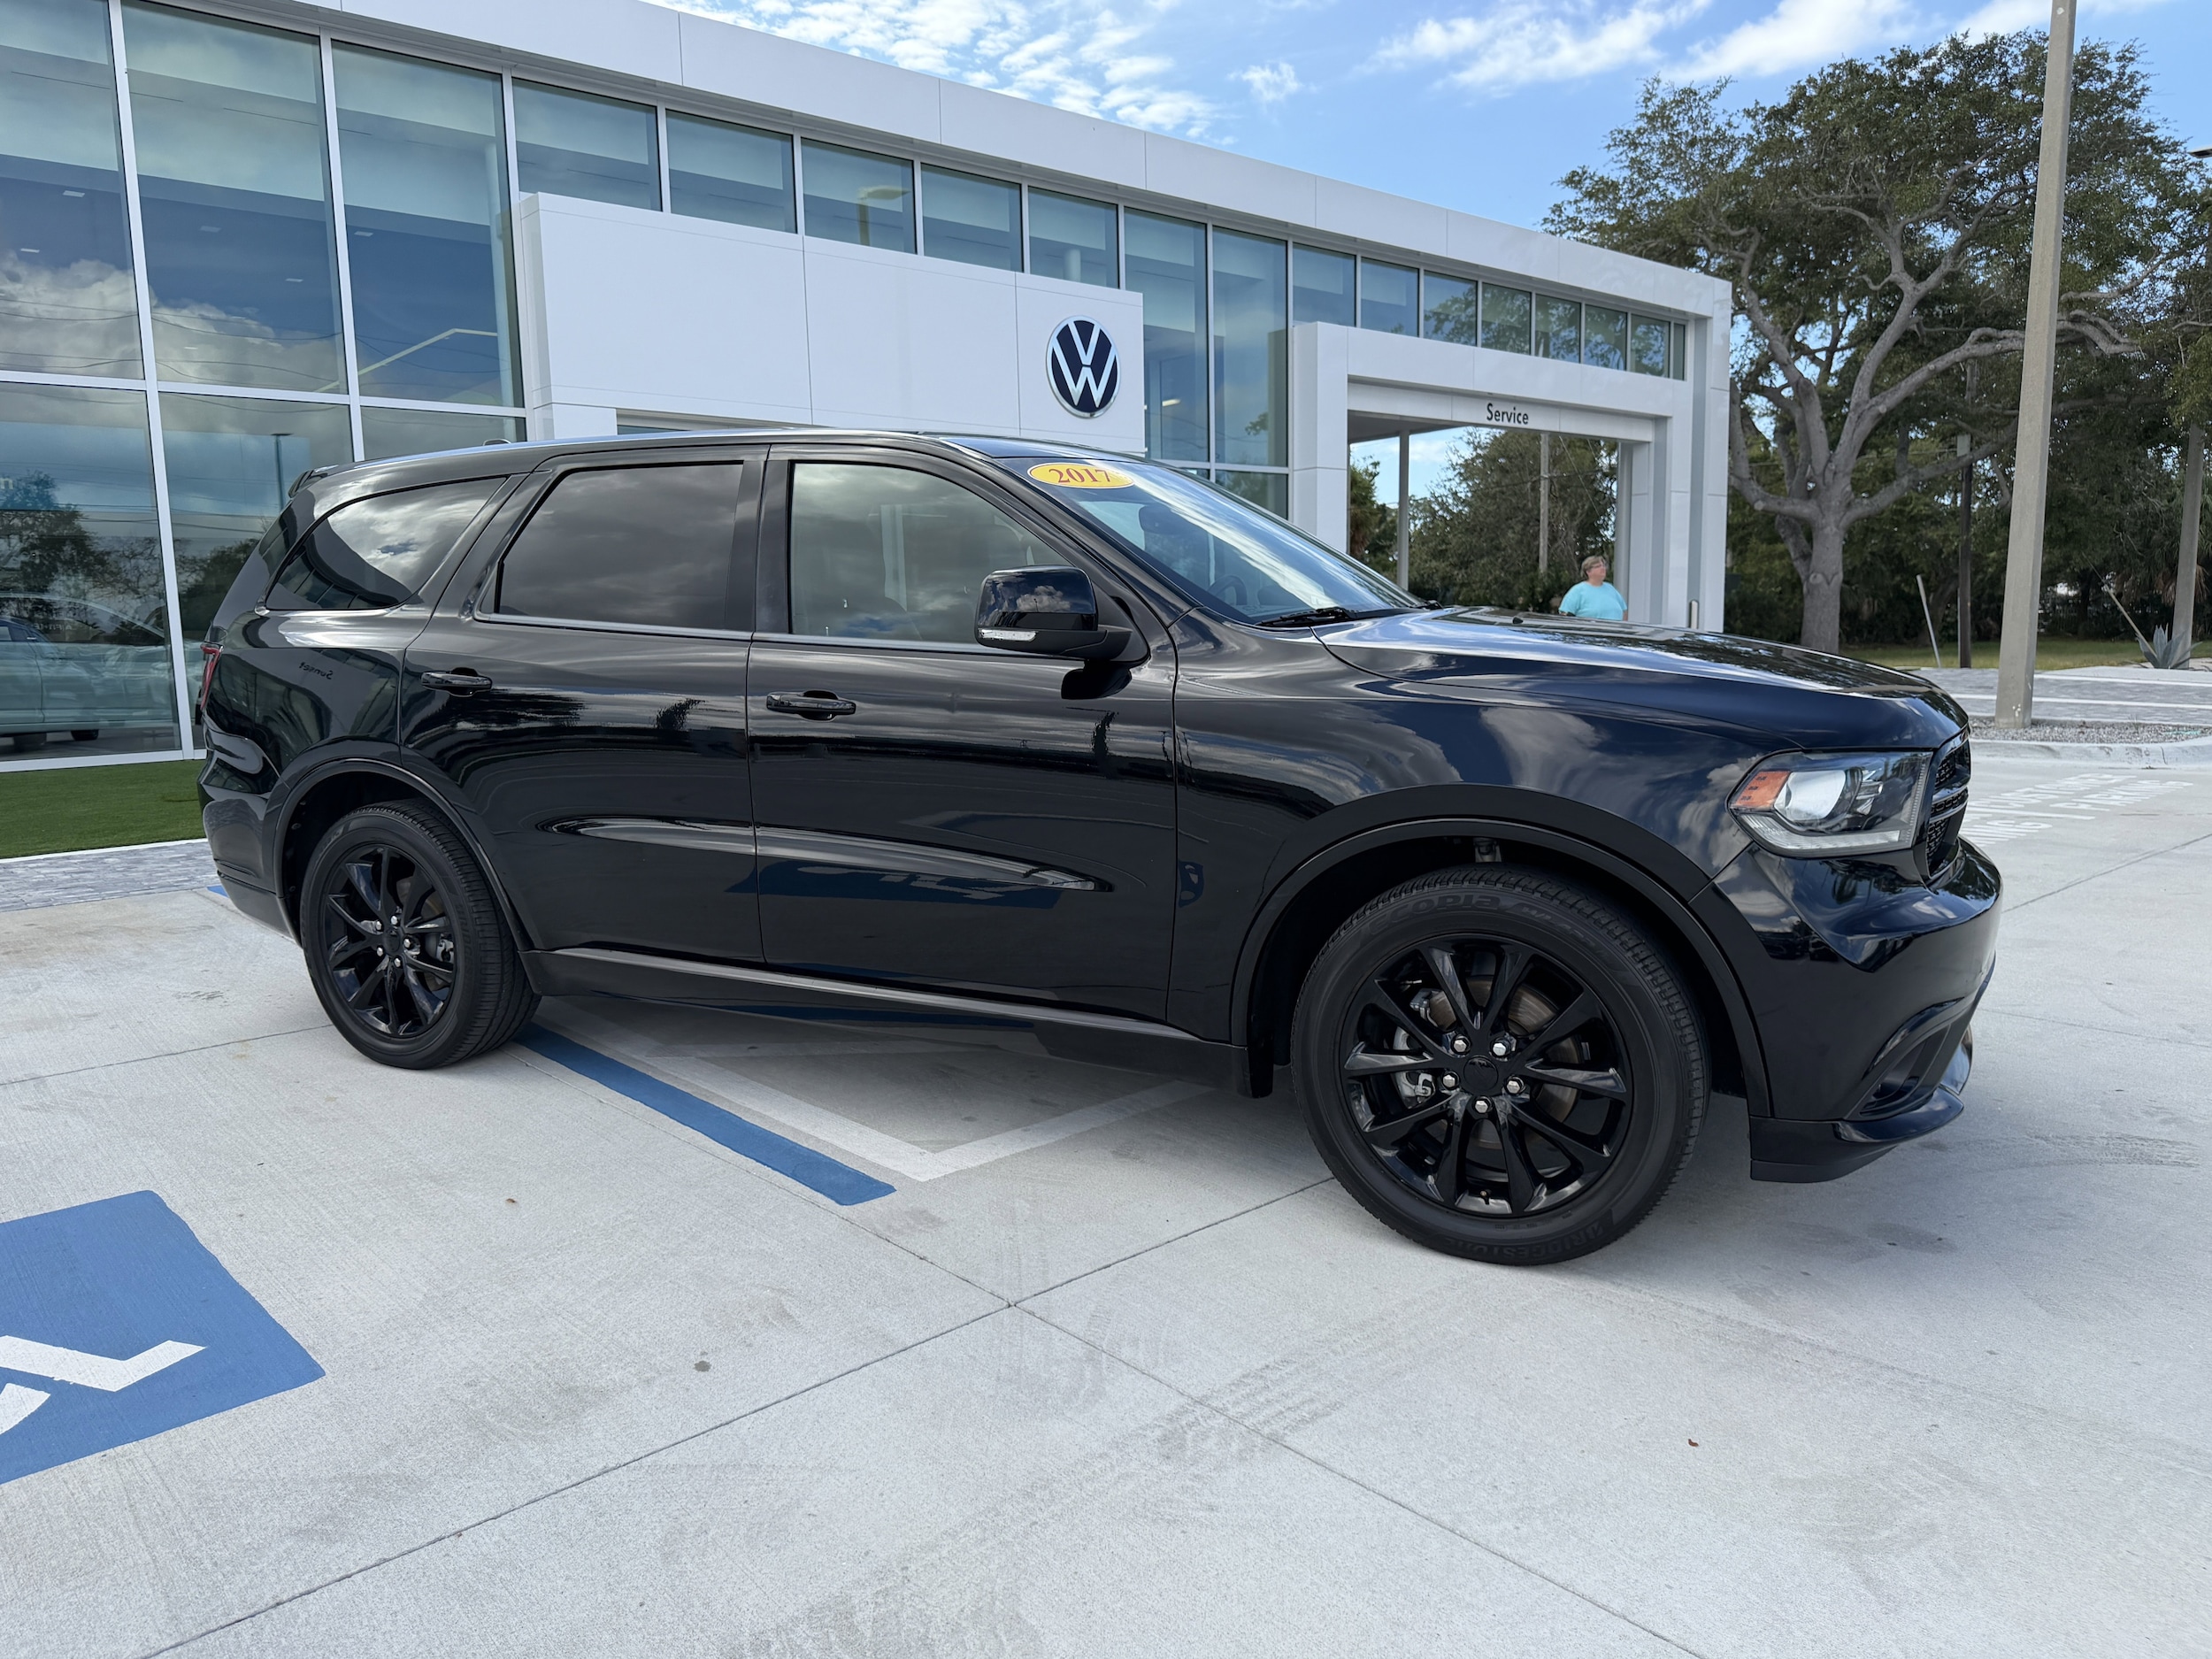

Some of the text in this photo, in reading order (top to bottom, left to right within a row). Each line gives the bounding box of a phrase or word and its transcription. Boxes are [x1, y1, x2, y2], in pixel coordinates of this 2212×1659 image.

[1049, 316, 1118, 409] VW
[1486, 403, 1529, 425] Service
[1048, 467, 1110, 483] 2017
[2049, 780, 2194, 811] PARKING
[1368, 893, 1502, 935] ECOPIA
